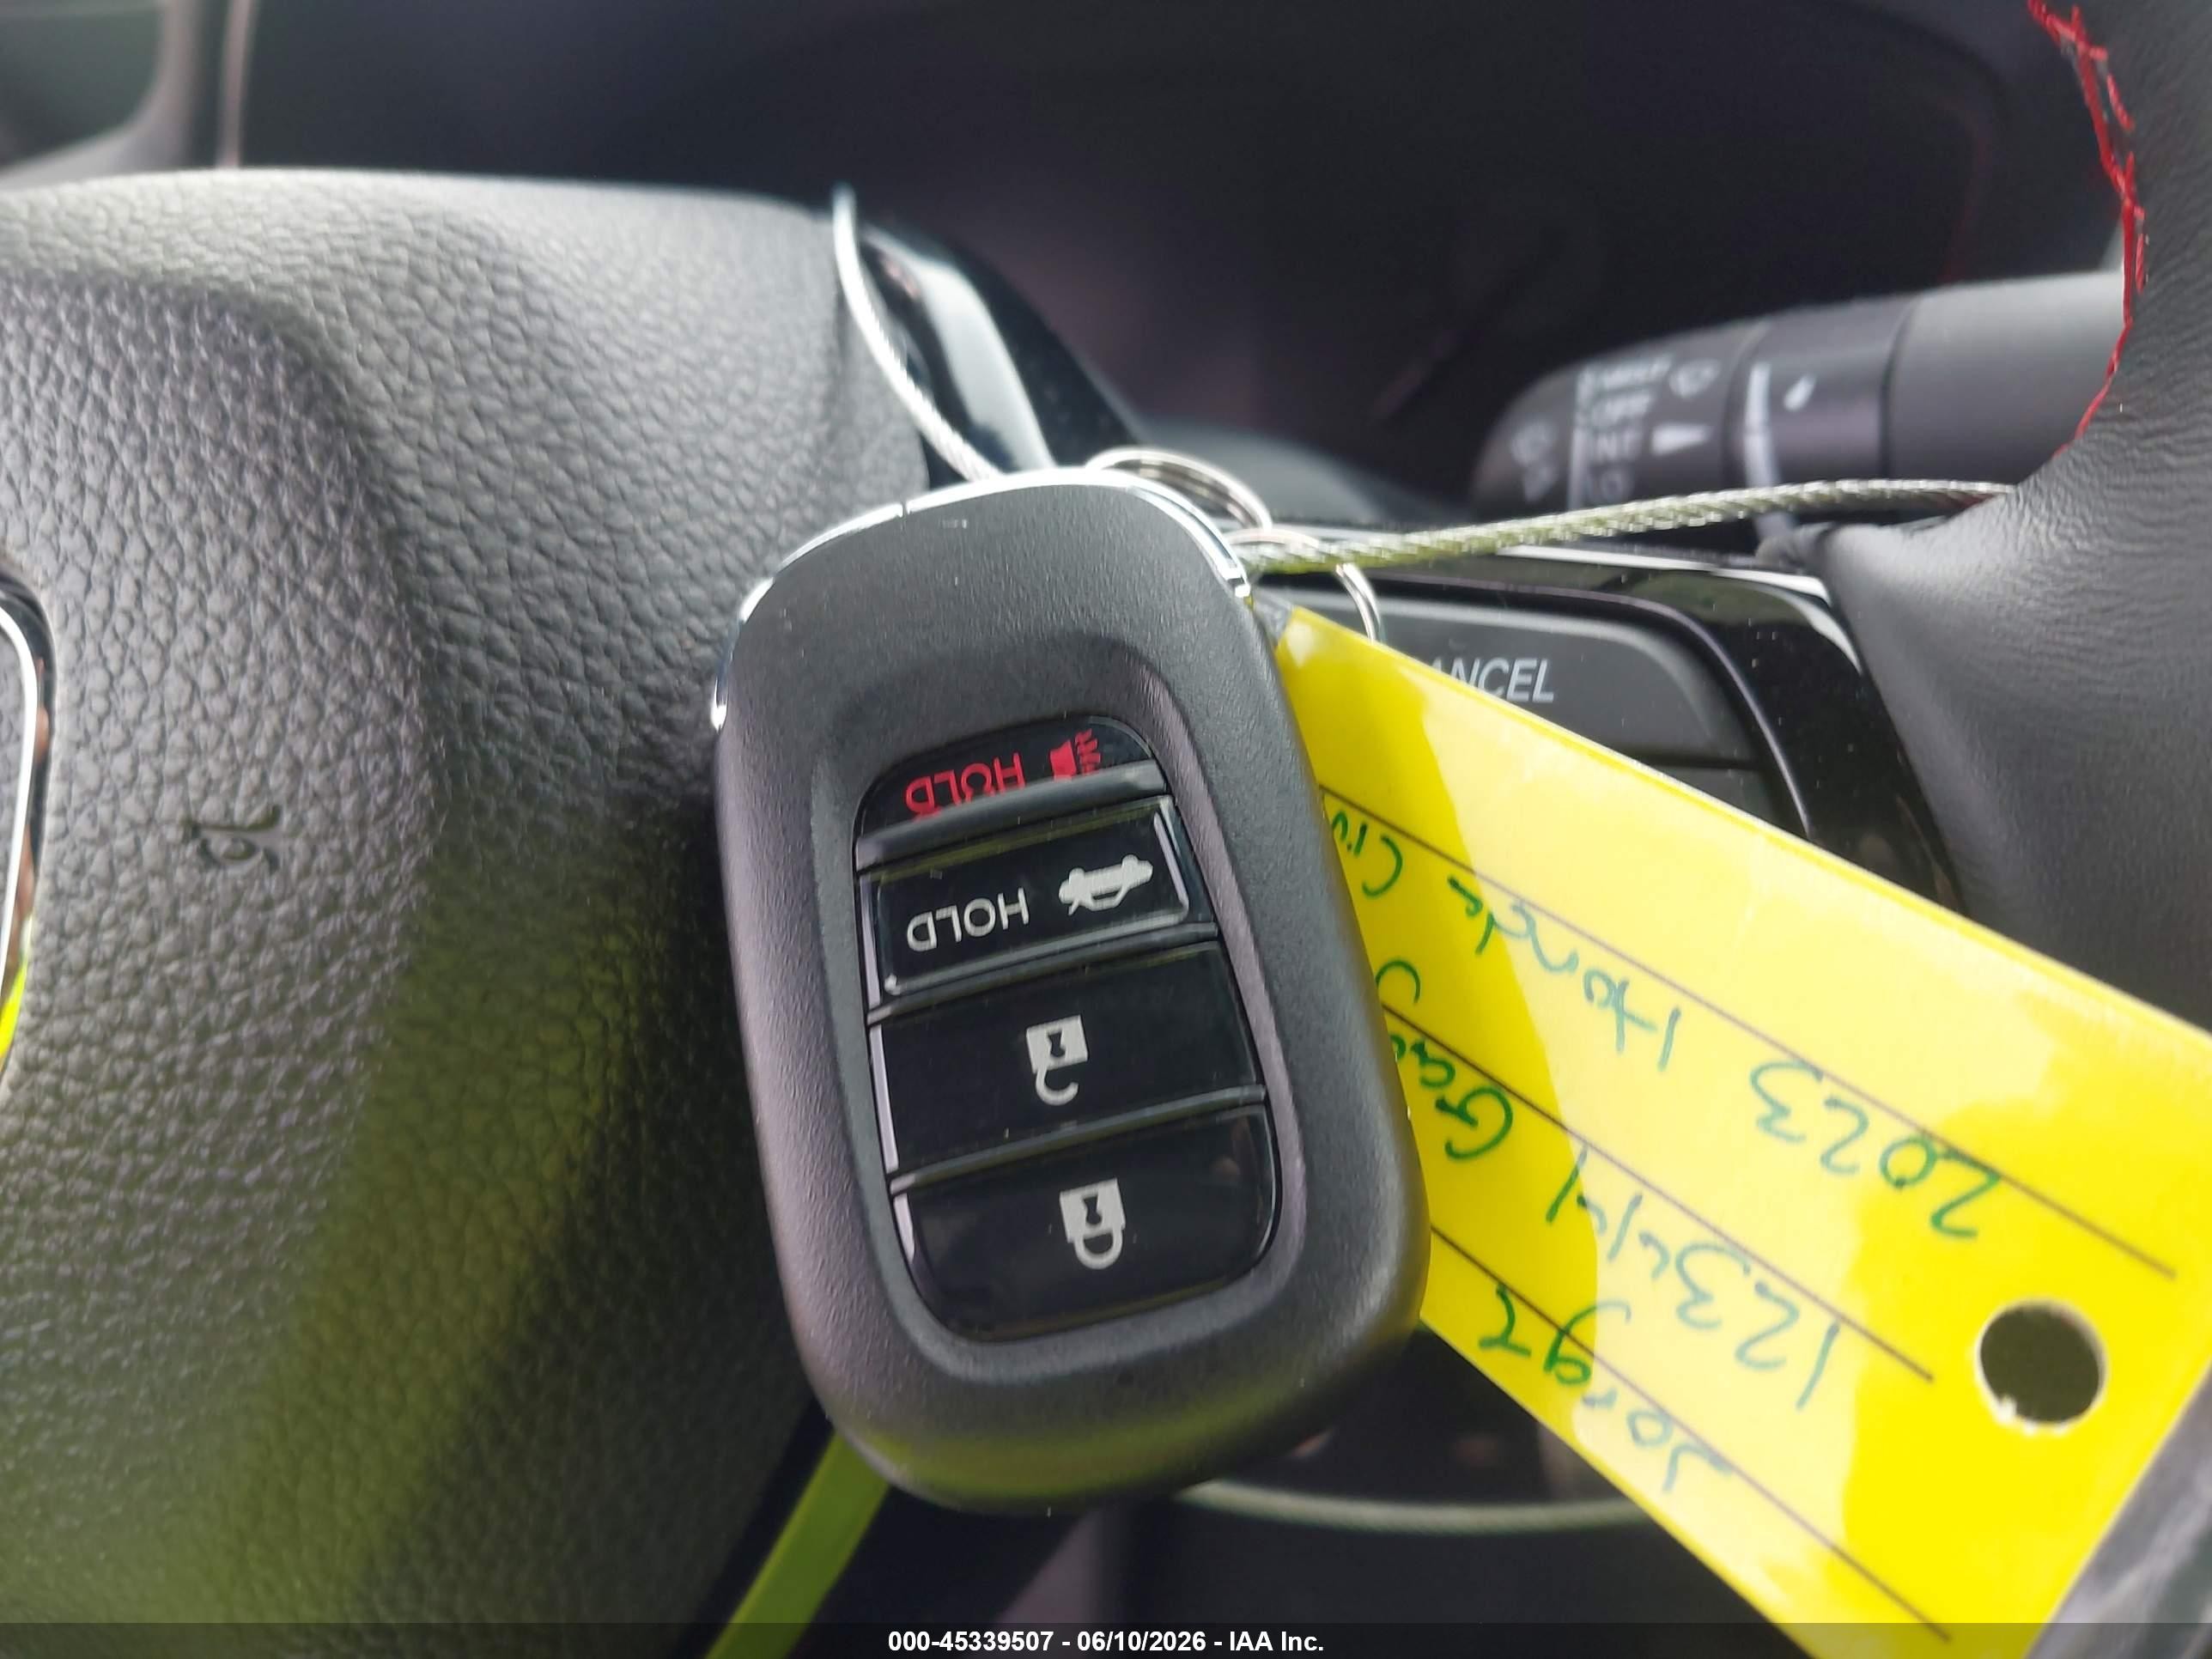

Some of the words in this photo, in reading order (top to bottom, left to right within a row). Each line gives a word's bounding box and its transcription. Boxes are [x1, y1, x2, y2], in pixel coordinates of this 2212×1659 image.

[905, 752, 1025, 822] HOLD
[907, 887, 1030, 951] HOLD
[1749, 1060, 2001, 1241] 2023
[1546, 1146, 1840, 1410] 12344
